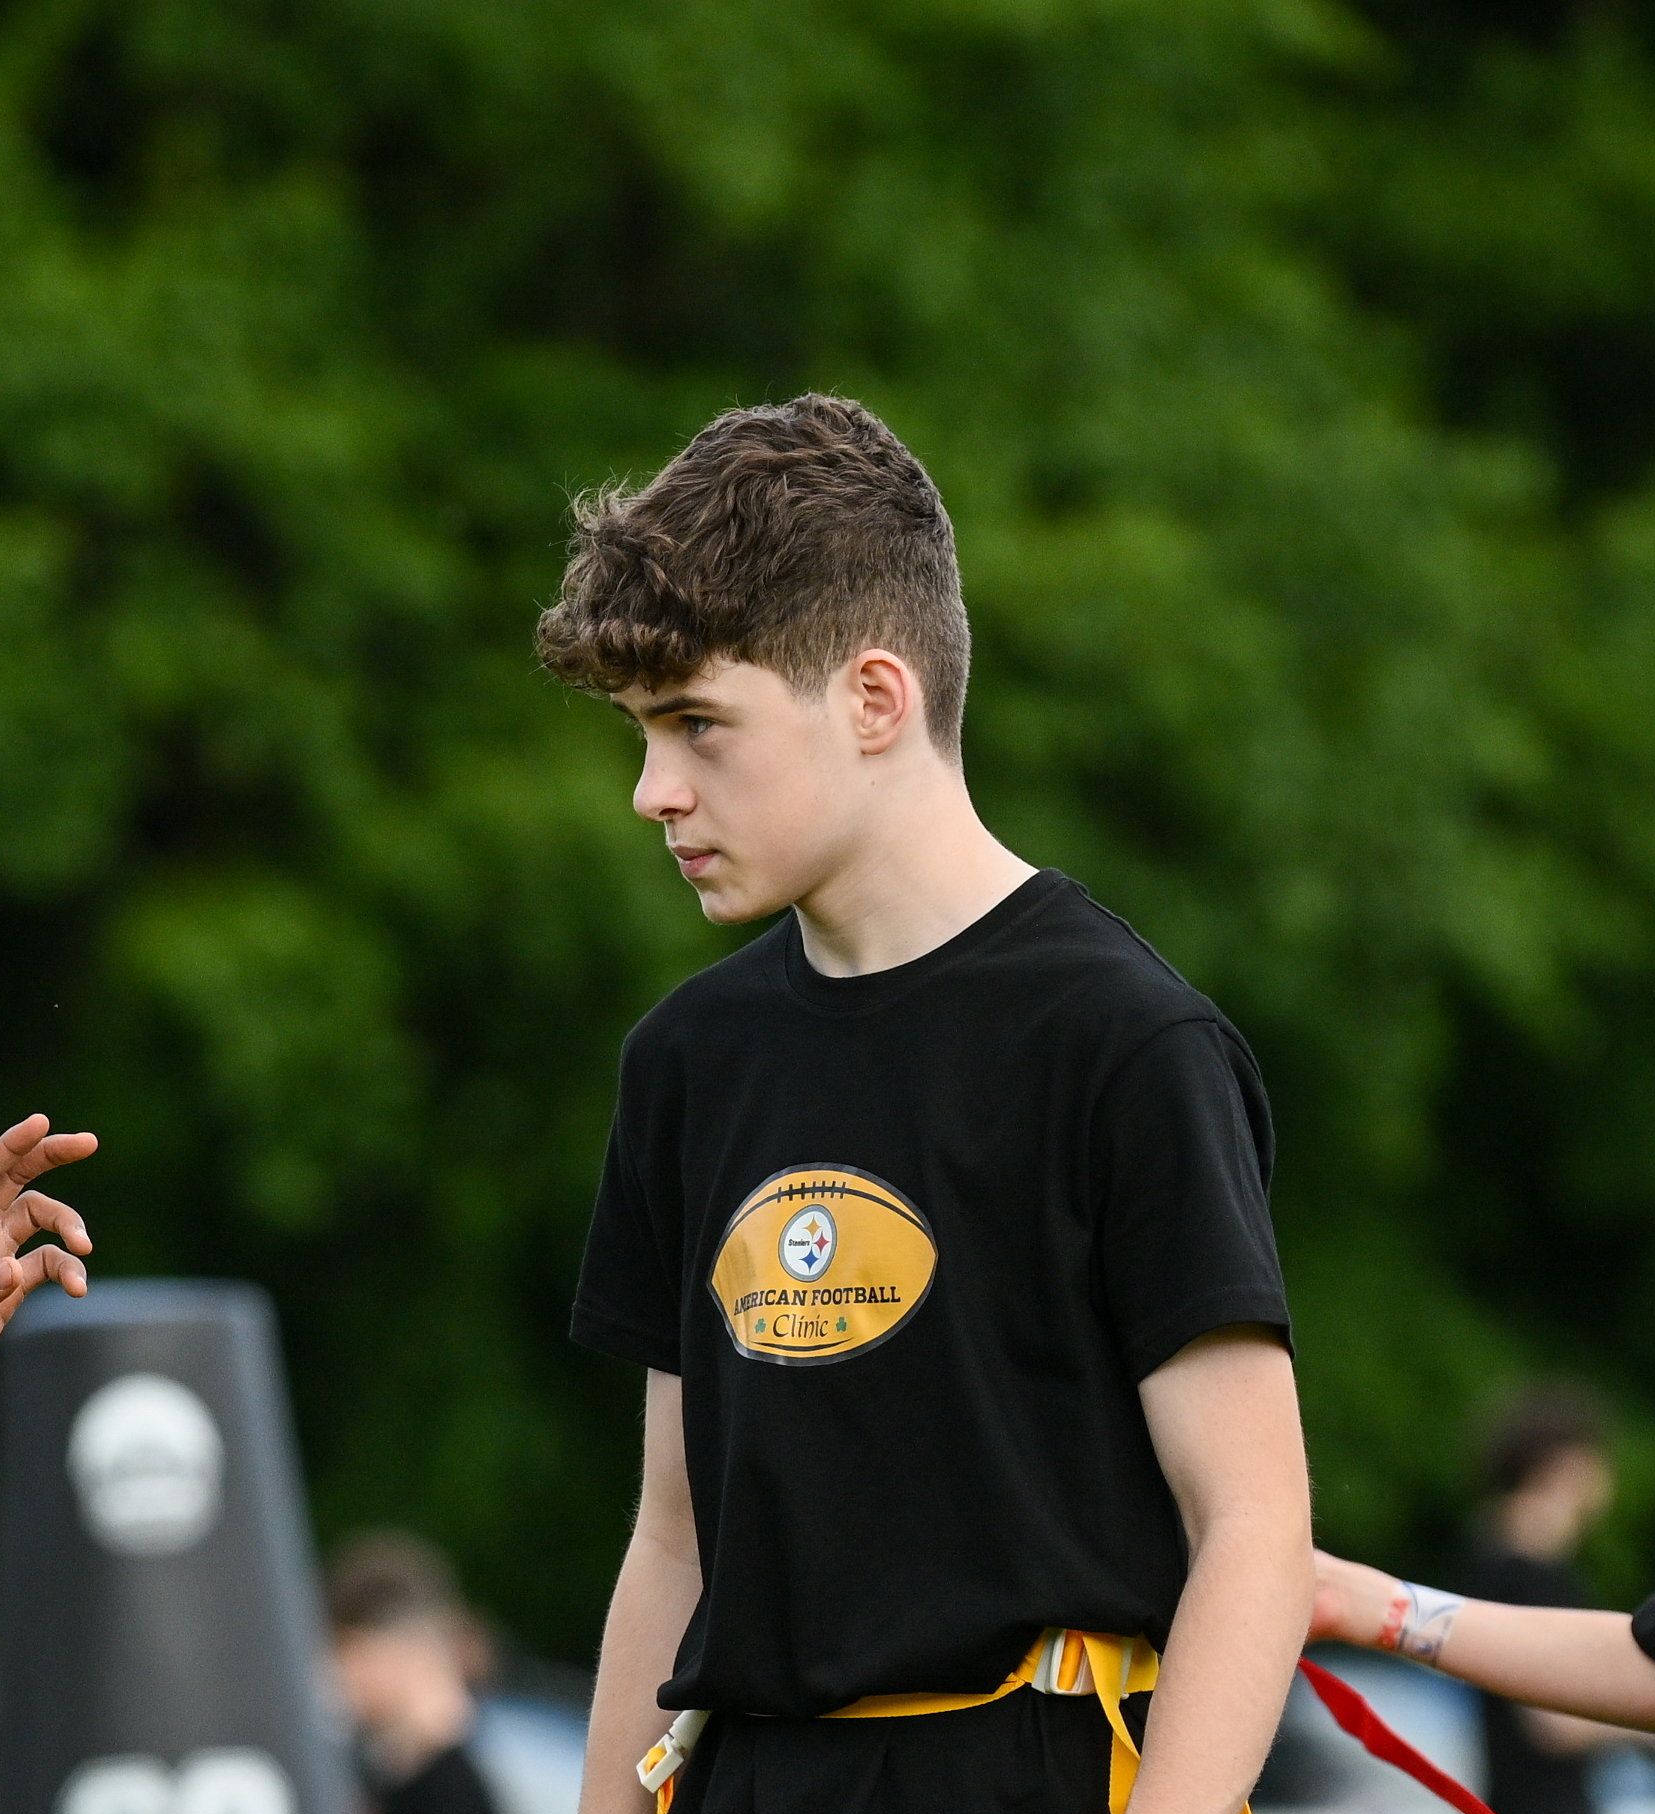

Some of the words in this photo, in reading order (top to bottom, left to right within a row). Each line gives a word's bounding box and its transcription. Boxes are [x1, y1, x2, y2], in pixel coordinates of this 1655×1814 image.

[733, 1289, 807, 1316] AMERICAN
[811, 1286, 901, 1306] FOOTBALL
[772, 1314, 829, 1339] Clinic
